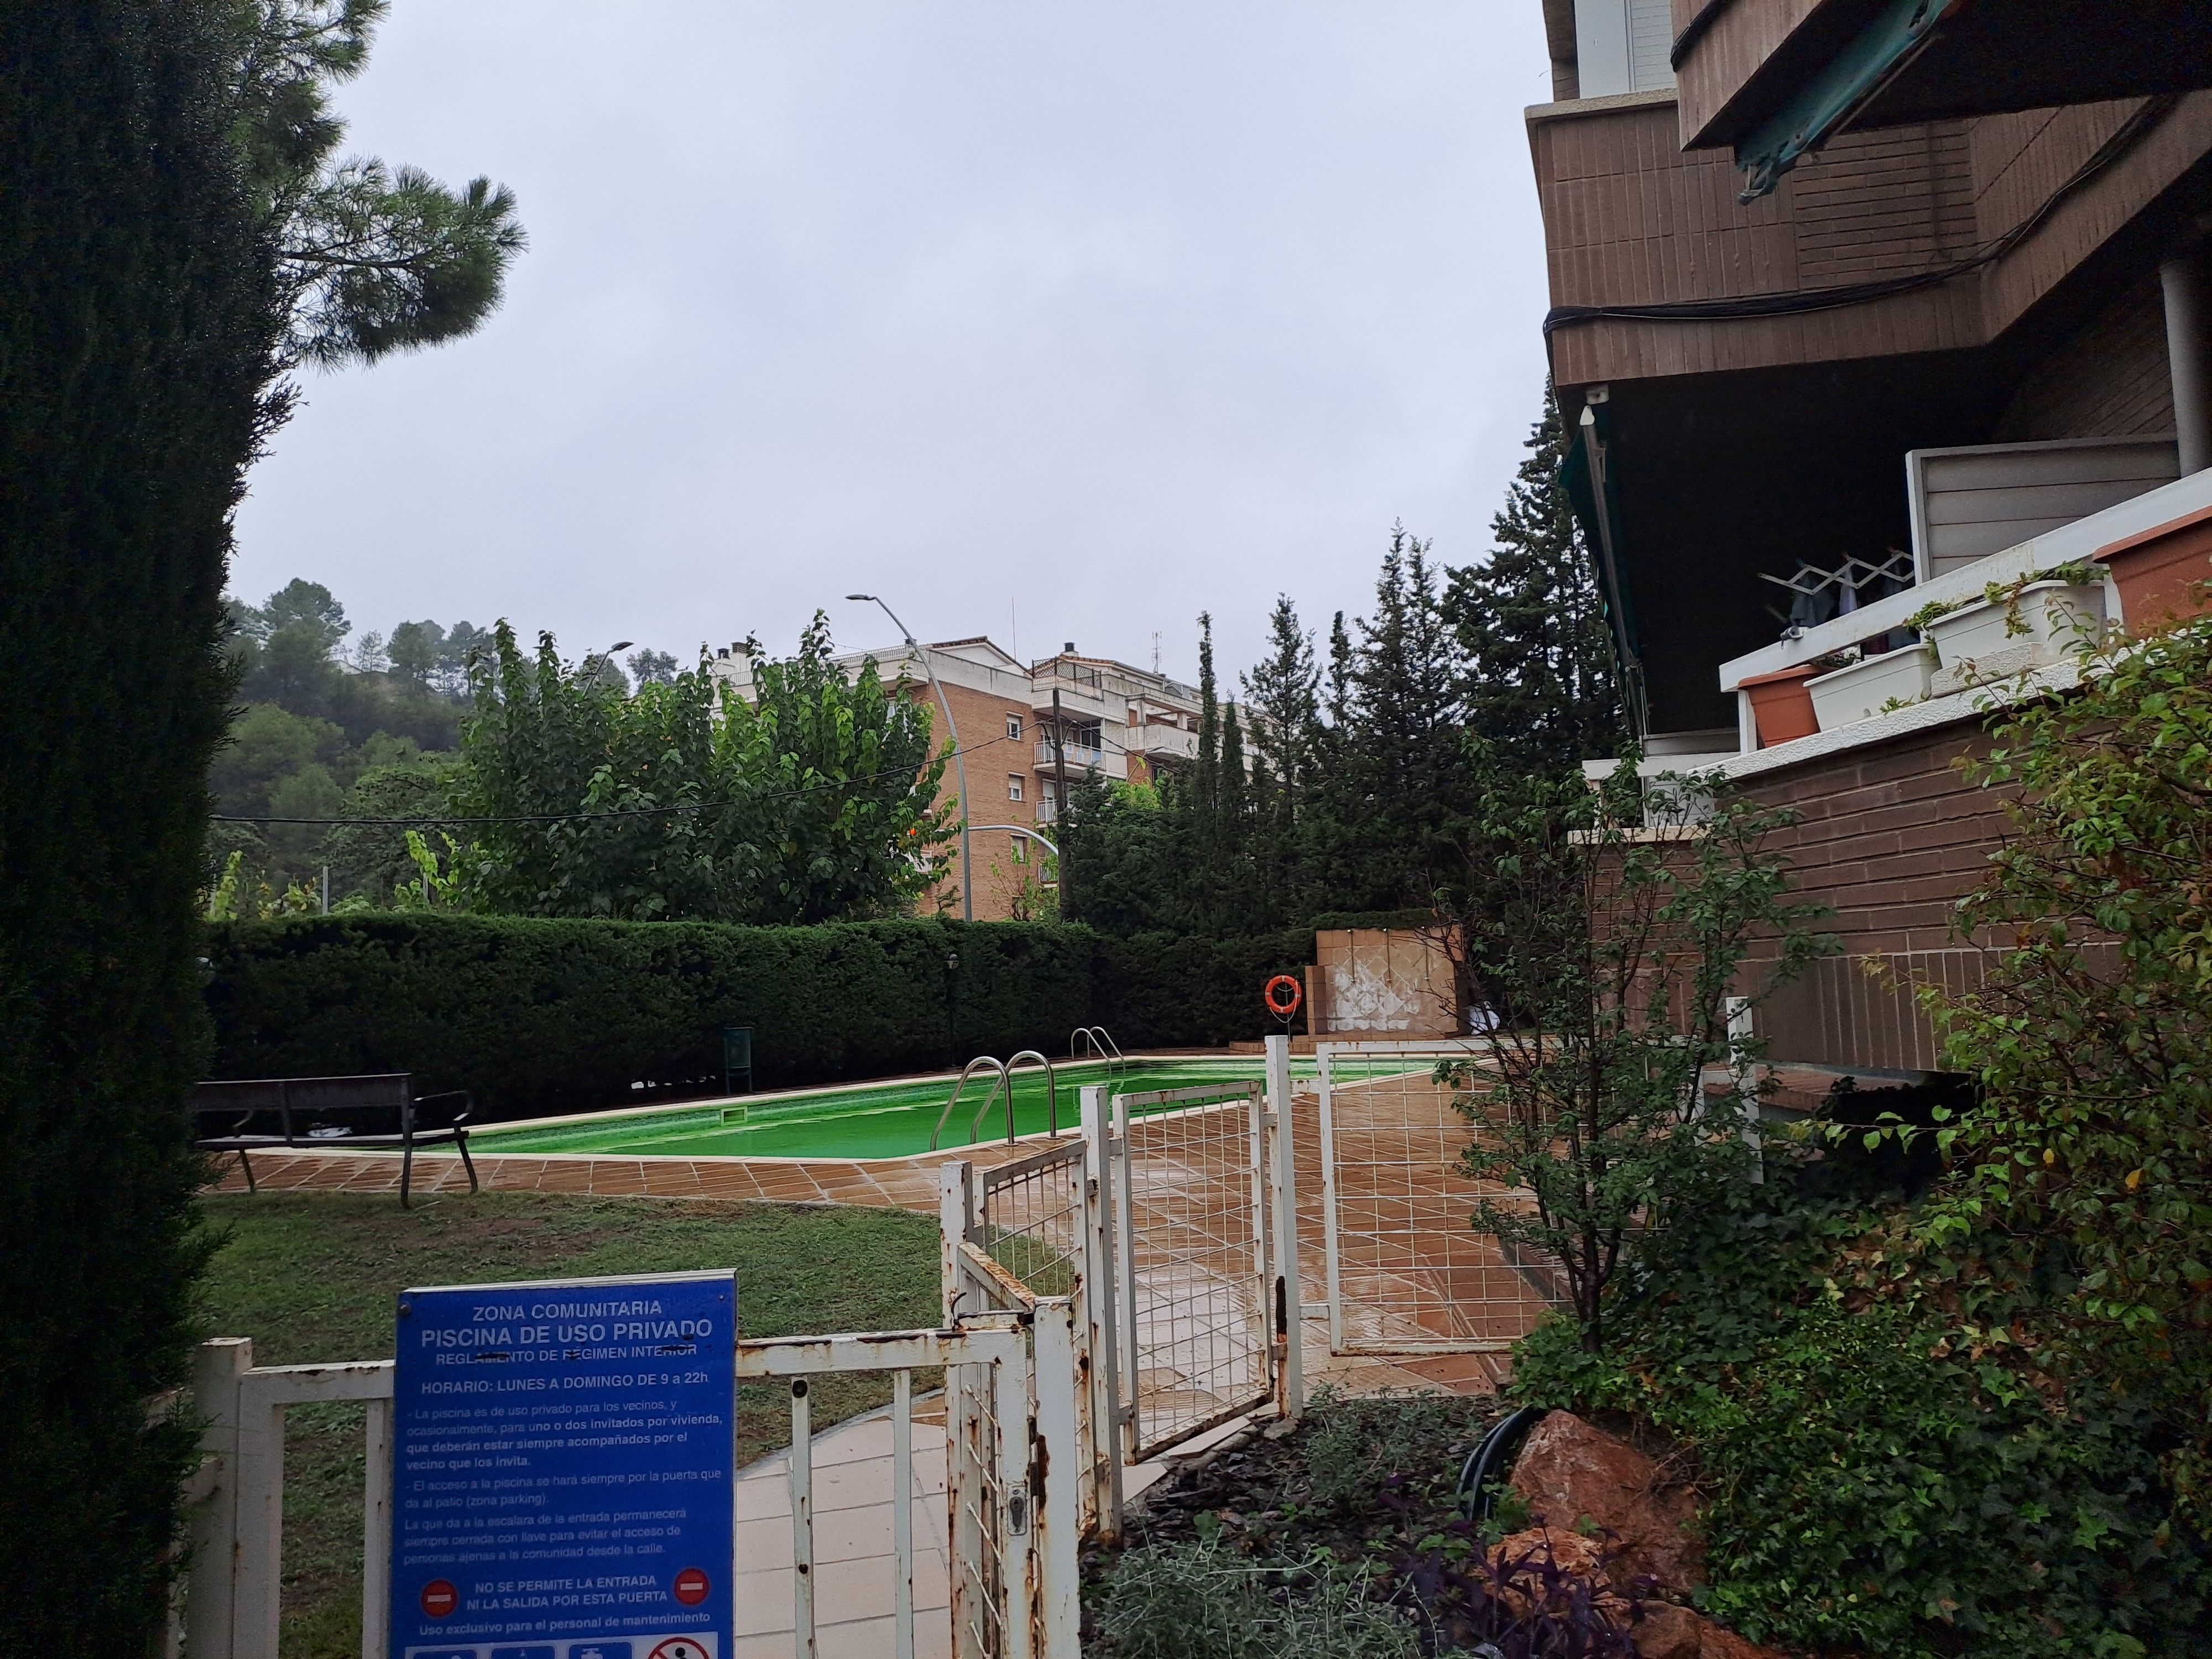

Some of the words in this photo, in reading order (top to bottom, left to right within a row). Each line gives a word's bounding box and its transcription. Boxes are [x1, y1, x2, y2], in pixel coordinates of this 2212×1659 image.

[473, 1306, 525, 1321] ZONA
[531, 1301, 661, 1318] COMUNITARIA
[422, 1328, 512, 1347] PISCINA
[520, 1326, 550, 1344] DE
[559, 1324, 605, 1342] USO
[614, 1319, 712, 1340] PRIVADO
[540, 1350, 557, 1361] DE
[422, 1380, 493, 1394] HORARIO:
[498, 1379, 545, 1391] LUNES
[549, 1378, 559, 1389] A
[564, 1375, 633, 1388] DOMINGO
[638, 1374, 656, 1385] DE
[661, 1374, 668, 1384] 9
[672, 1375, 680, 1384] a
[685, 1372, 708, 1383] 22h
[415, 1410, 429, 1419] La
[432, 1410, 471, 1420] piscina
[491, 1407, 504, 1416] de
[508, 1407, 528, 1416] uso
[531, 1404, 572, 1416] privado
[575, 1405, 600, 1415] para
[604, 1402, 619, 1411] los
[671, 1401, 677, 1411] y
[500, 1424, 525, 1435] para
[565, 1421, 587, 1430] dos
[591, 1418, 644, 1428] invitados
[648, 1418, 667, 1428] por
[671, 1414, 722, 1425] vivienda,
[406, 1445, 429, 1455] que
[432, 1441, 480, 1452] deberán
[483, 1441, 514, 1450] estar
[517, 1439, 564, 1449] siempre
[567, 1434, 650, 1447] acompañados
[654, 1434, 674, 1445] por
[677, 1432, 687, 1442] el
[406, 1459, 445, 1470] vecino
[448, 1460, 471, 1470] que
[475, 1458, 492, 1467] los
[496, 1456, 530, 1466] invita.
[414, 1480, 424, 1491] El
[428, 1481, 467, 1490] acceso
[481, 1479, 491, 1488] la
[494, 1478, 533, 1490] piscina
[581, 1475, 625, 1485] siempre
[628, 1474, 646, 1484] por
[650, 1471, 659, 1481] la
[662, 1471, 697, 1483] puerta
[701, 1470, 721, 1481] que
[405, 1499, 419, 1508] da
[422, 1498, 432, 1507] al
[436, 1498, 463, 1509] patio
[466, 1496, 497, 1507] (zona
[405, 1520, 418, 1530] La
[422, 1520, 443, 1531] que
[446, 1519, 460, 1528] da
[474, 1517, 484, 1527] la
[538, 1515, 552, 1524] de
[555, 1514, 565, 1524] la
[568, 1512, 610, 1523] entrada
[404, 1537, 448, 1548] siempre
[452, 1534, 494, 1545] cerrada
[497, 1535, 518, 1543] con
[521, 1532, 546, 1542] llave
[550, 1532, 575, 1542] para
[578, 1530, 608, 1540] evitar
[611, 1528, 621, 1538] el
[624, 1528, 664, 1537] acceso
[667, 1526, 680, 1535] de
[404, 1554, 456, 1566] personas
[458, 1552, 495, 1563] ajenas
[509, 1550, 519, 1559] la
[522, 1547, 583, 1558] comunidad
[587, 1545, 621, 1556] desde
[624, 1545, 633, 1554] la
[476, 1583, 494, 1593] NO
[498, 1582, 514, 1592] SE
[518, 1579, 572, 1591] PERMITE
[577, 1578, 593, 1588] LA
[597, 1575, 656, 1588] ENTRADA
[467, 1600, 479, 1610] NI
[483, 1599, 499, 1609] LA
[503, 1597, 549, 1608] SALIDA
[553, 1595, 579, 1606] POR
[584, 1594, 614, 1605] ESTA
[619, 1591, 667, 1602] PUERTA
[420, 1625, 443, 1635] Uso
[446, 1623, 503, 1634] exclusivo
[506, 1623, 532, 1634] para
[535, 1620, 546, 1630] el
[550, 1617, 601, 1631] personal
[605, 1617, 619, 1626] de
[623, 1613, 710, 1625] mantenimiento
